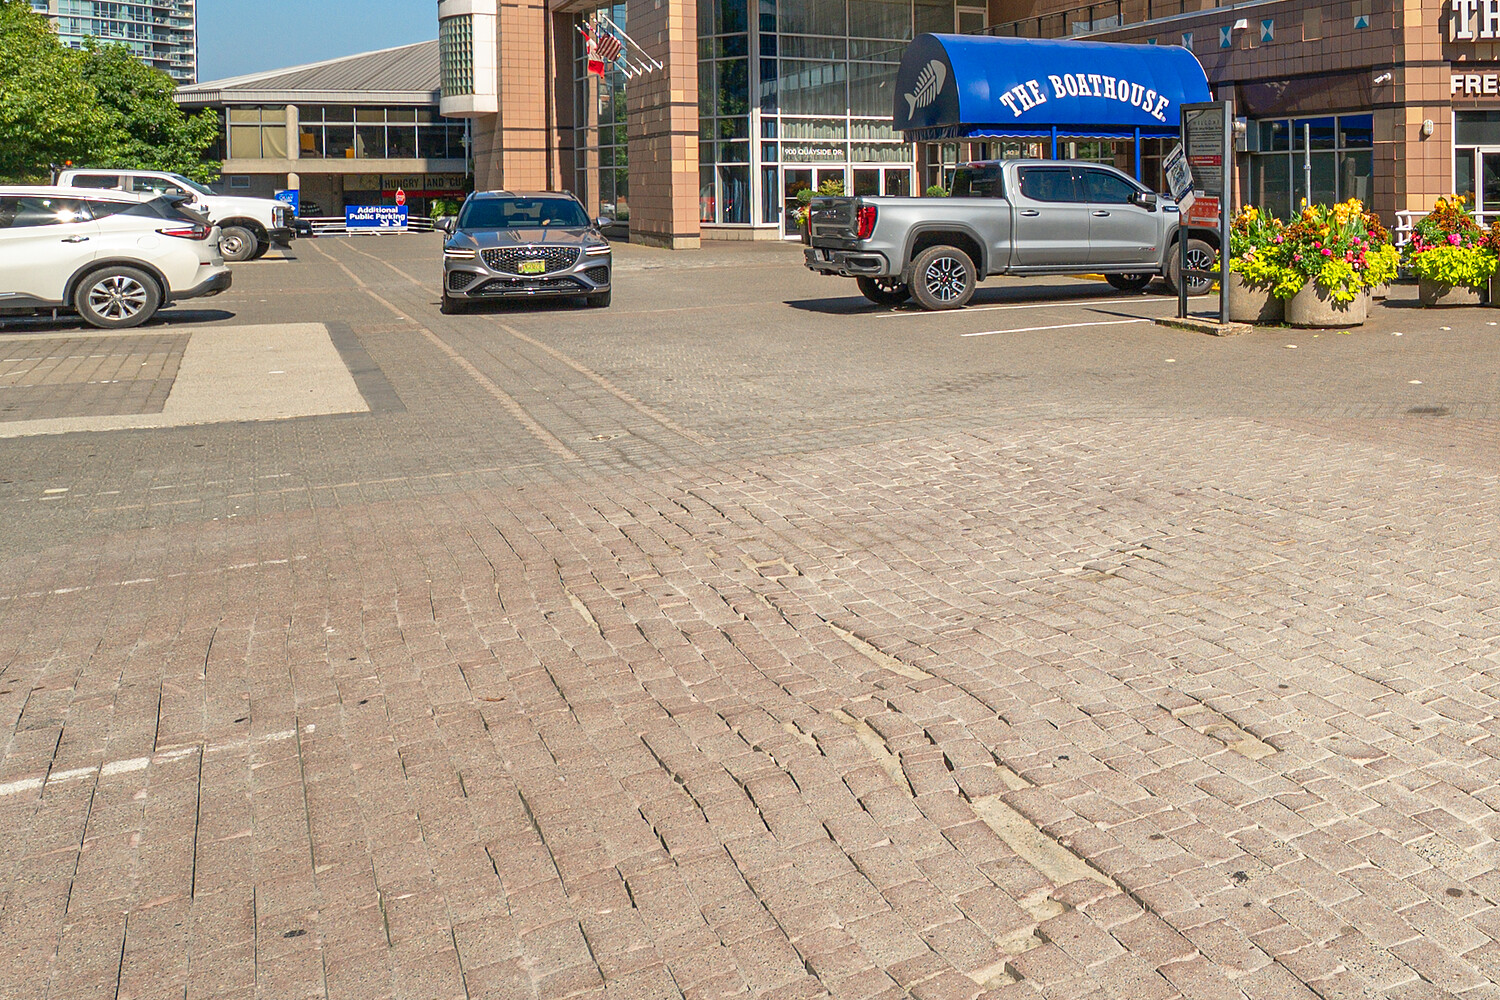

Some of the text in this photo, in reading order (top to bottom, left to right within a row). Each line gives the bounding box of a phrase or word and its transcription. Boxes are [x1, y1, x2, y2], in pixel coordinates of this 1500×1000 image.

[999, 73, 1170, 121] THE BOATHOUSE
[385, 179, 419, 189] HUNGRY
[427, 177, 443, 187] AND
[375, 213, 406, 221] Parking
